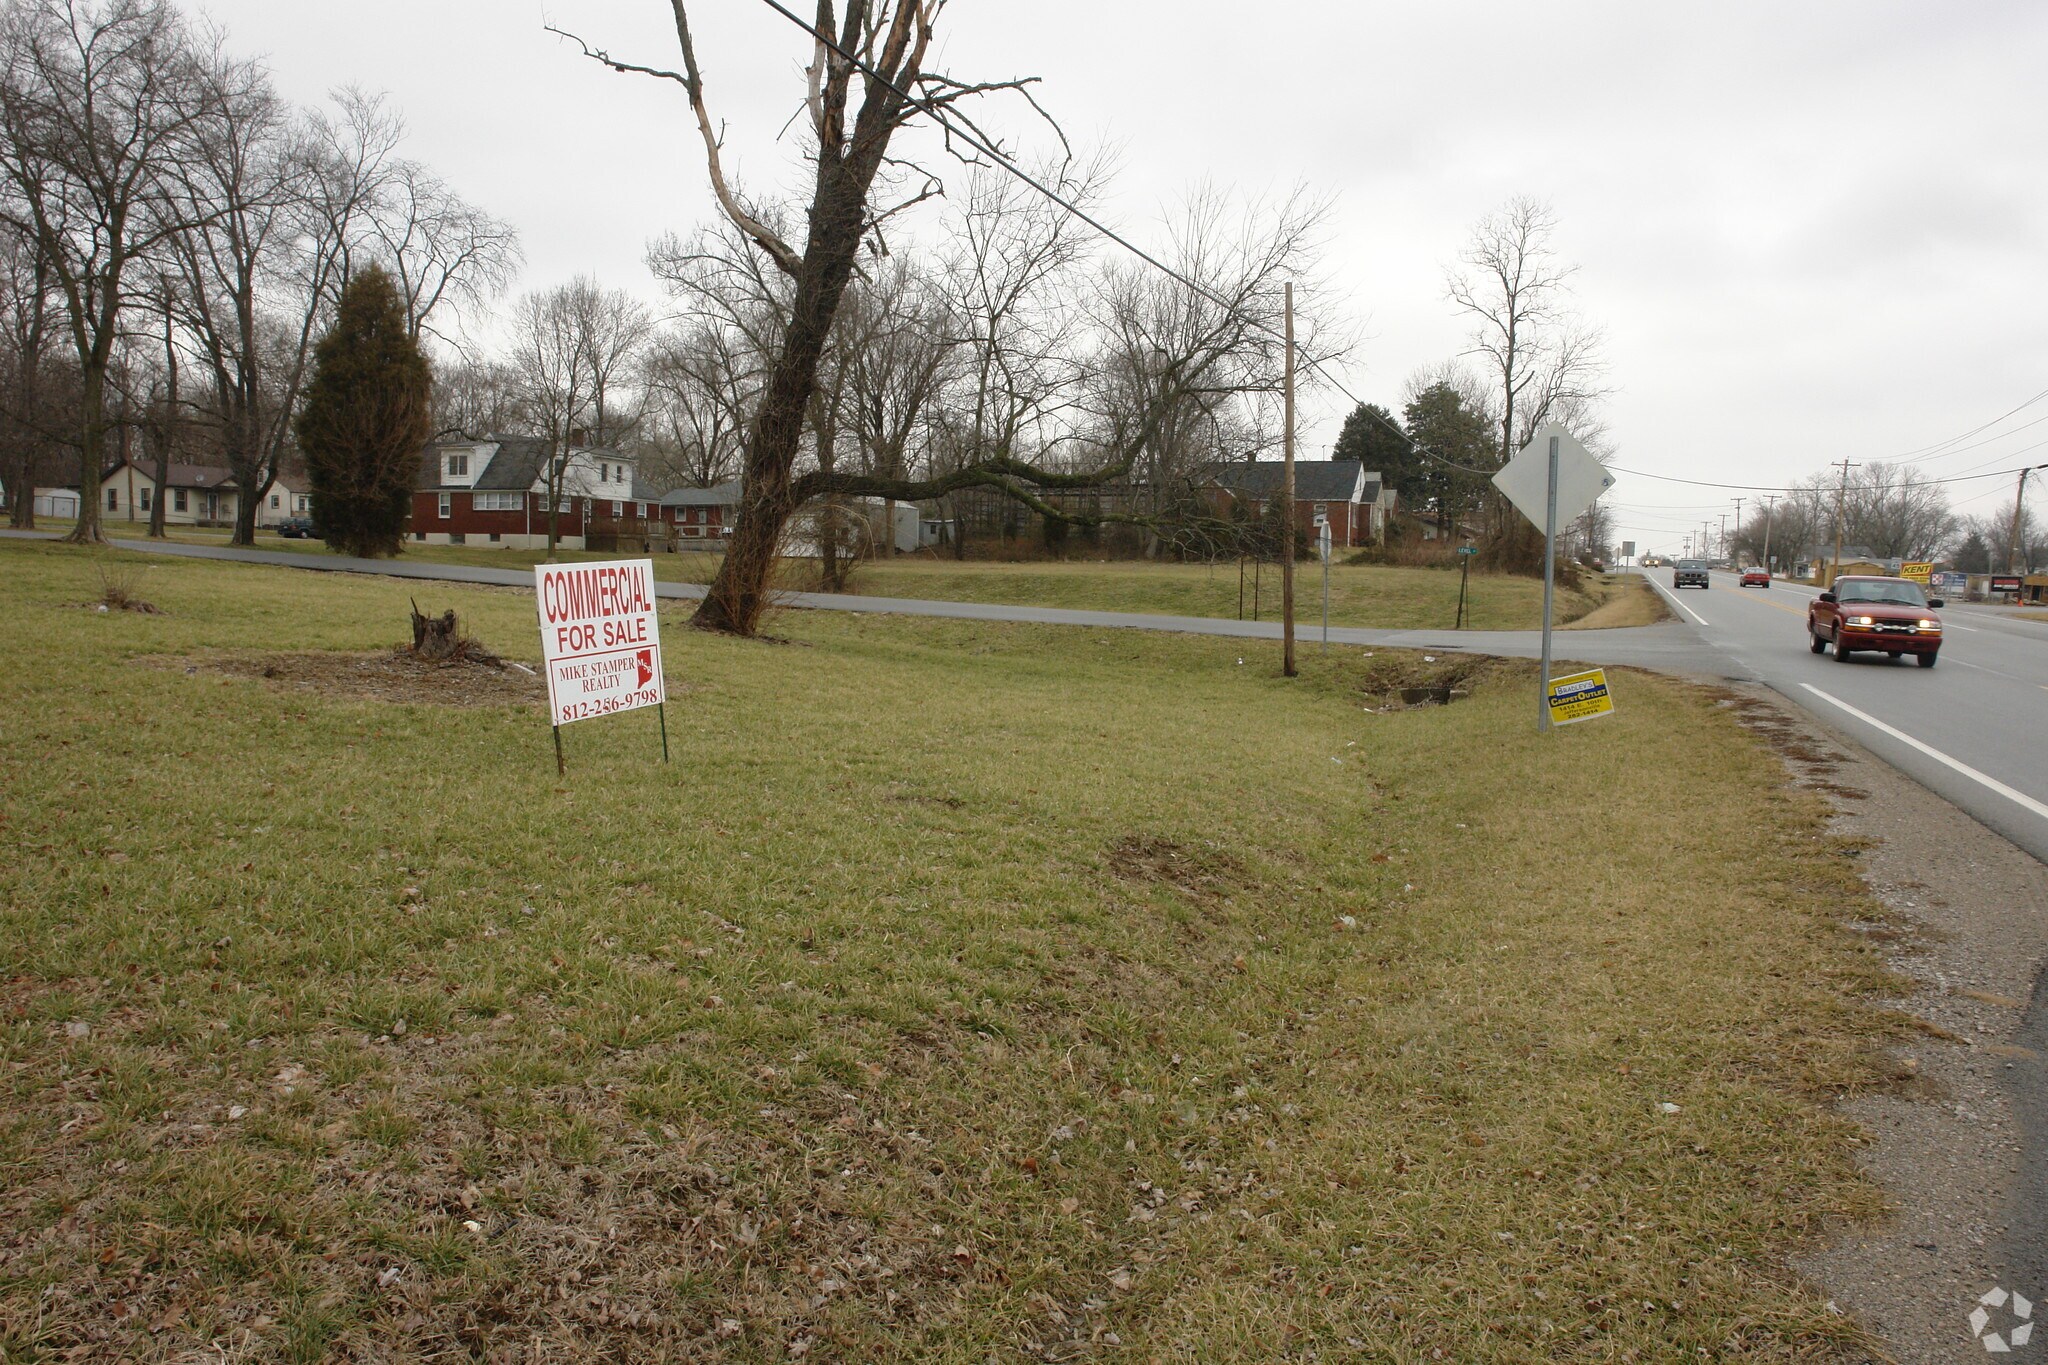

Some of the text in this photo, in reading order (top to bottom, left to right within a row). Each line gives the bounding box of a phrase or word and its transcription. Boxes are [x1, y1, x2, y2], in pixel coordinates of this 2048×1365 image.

[1903, 565, 1930, 574] KENT
[544, 566, 651, 624] COMMERCIAL
[557, 617, 648, 653] FOR SALE
[559, 656, 636, 682] MIKE STAMPER
[637, 658, 653, 674] MSR
[582, 674, 622, 693] REALTY
